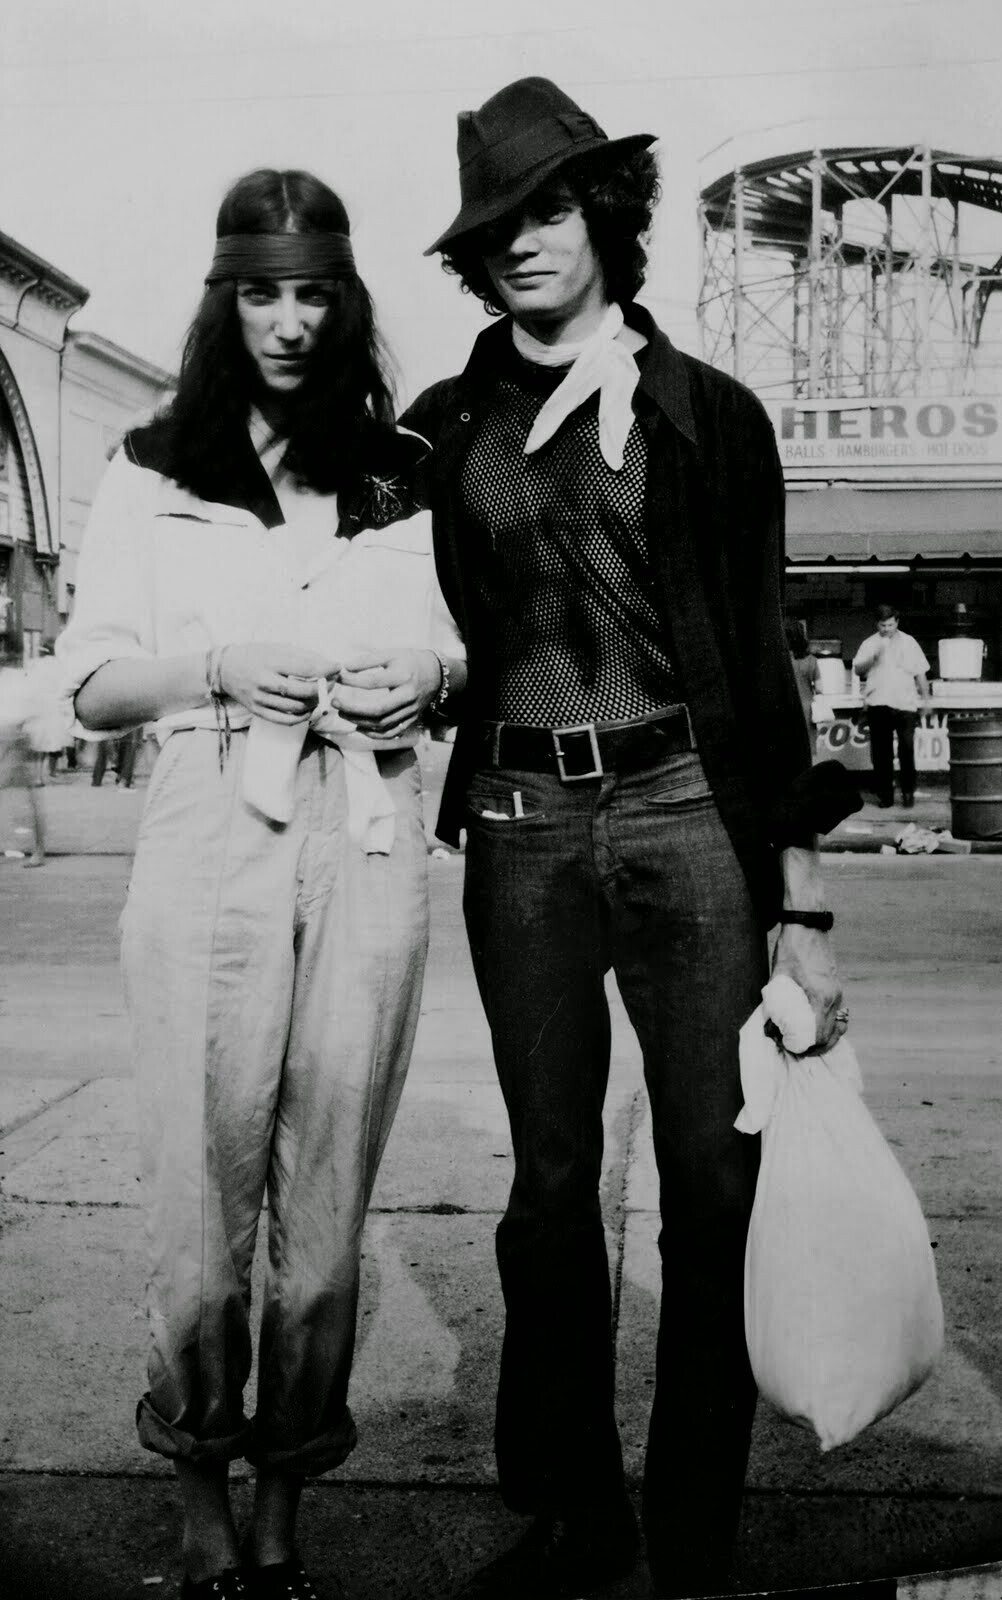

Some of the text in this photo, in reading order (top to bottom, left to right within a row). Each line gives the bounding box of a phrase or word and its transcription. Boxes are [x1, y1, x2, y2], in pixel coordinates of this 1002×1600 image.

[781, 402, 998, 440] HEROS
[785, 444, 825, 459] BALLS
[837, 442, 915, 458] HAMBURGERS
[819, 722, 870, 747] OS
